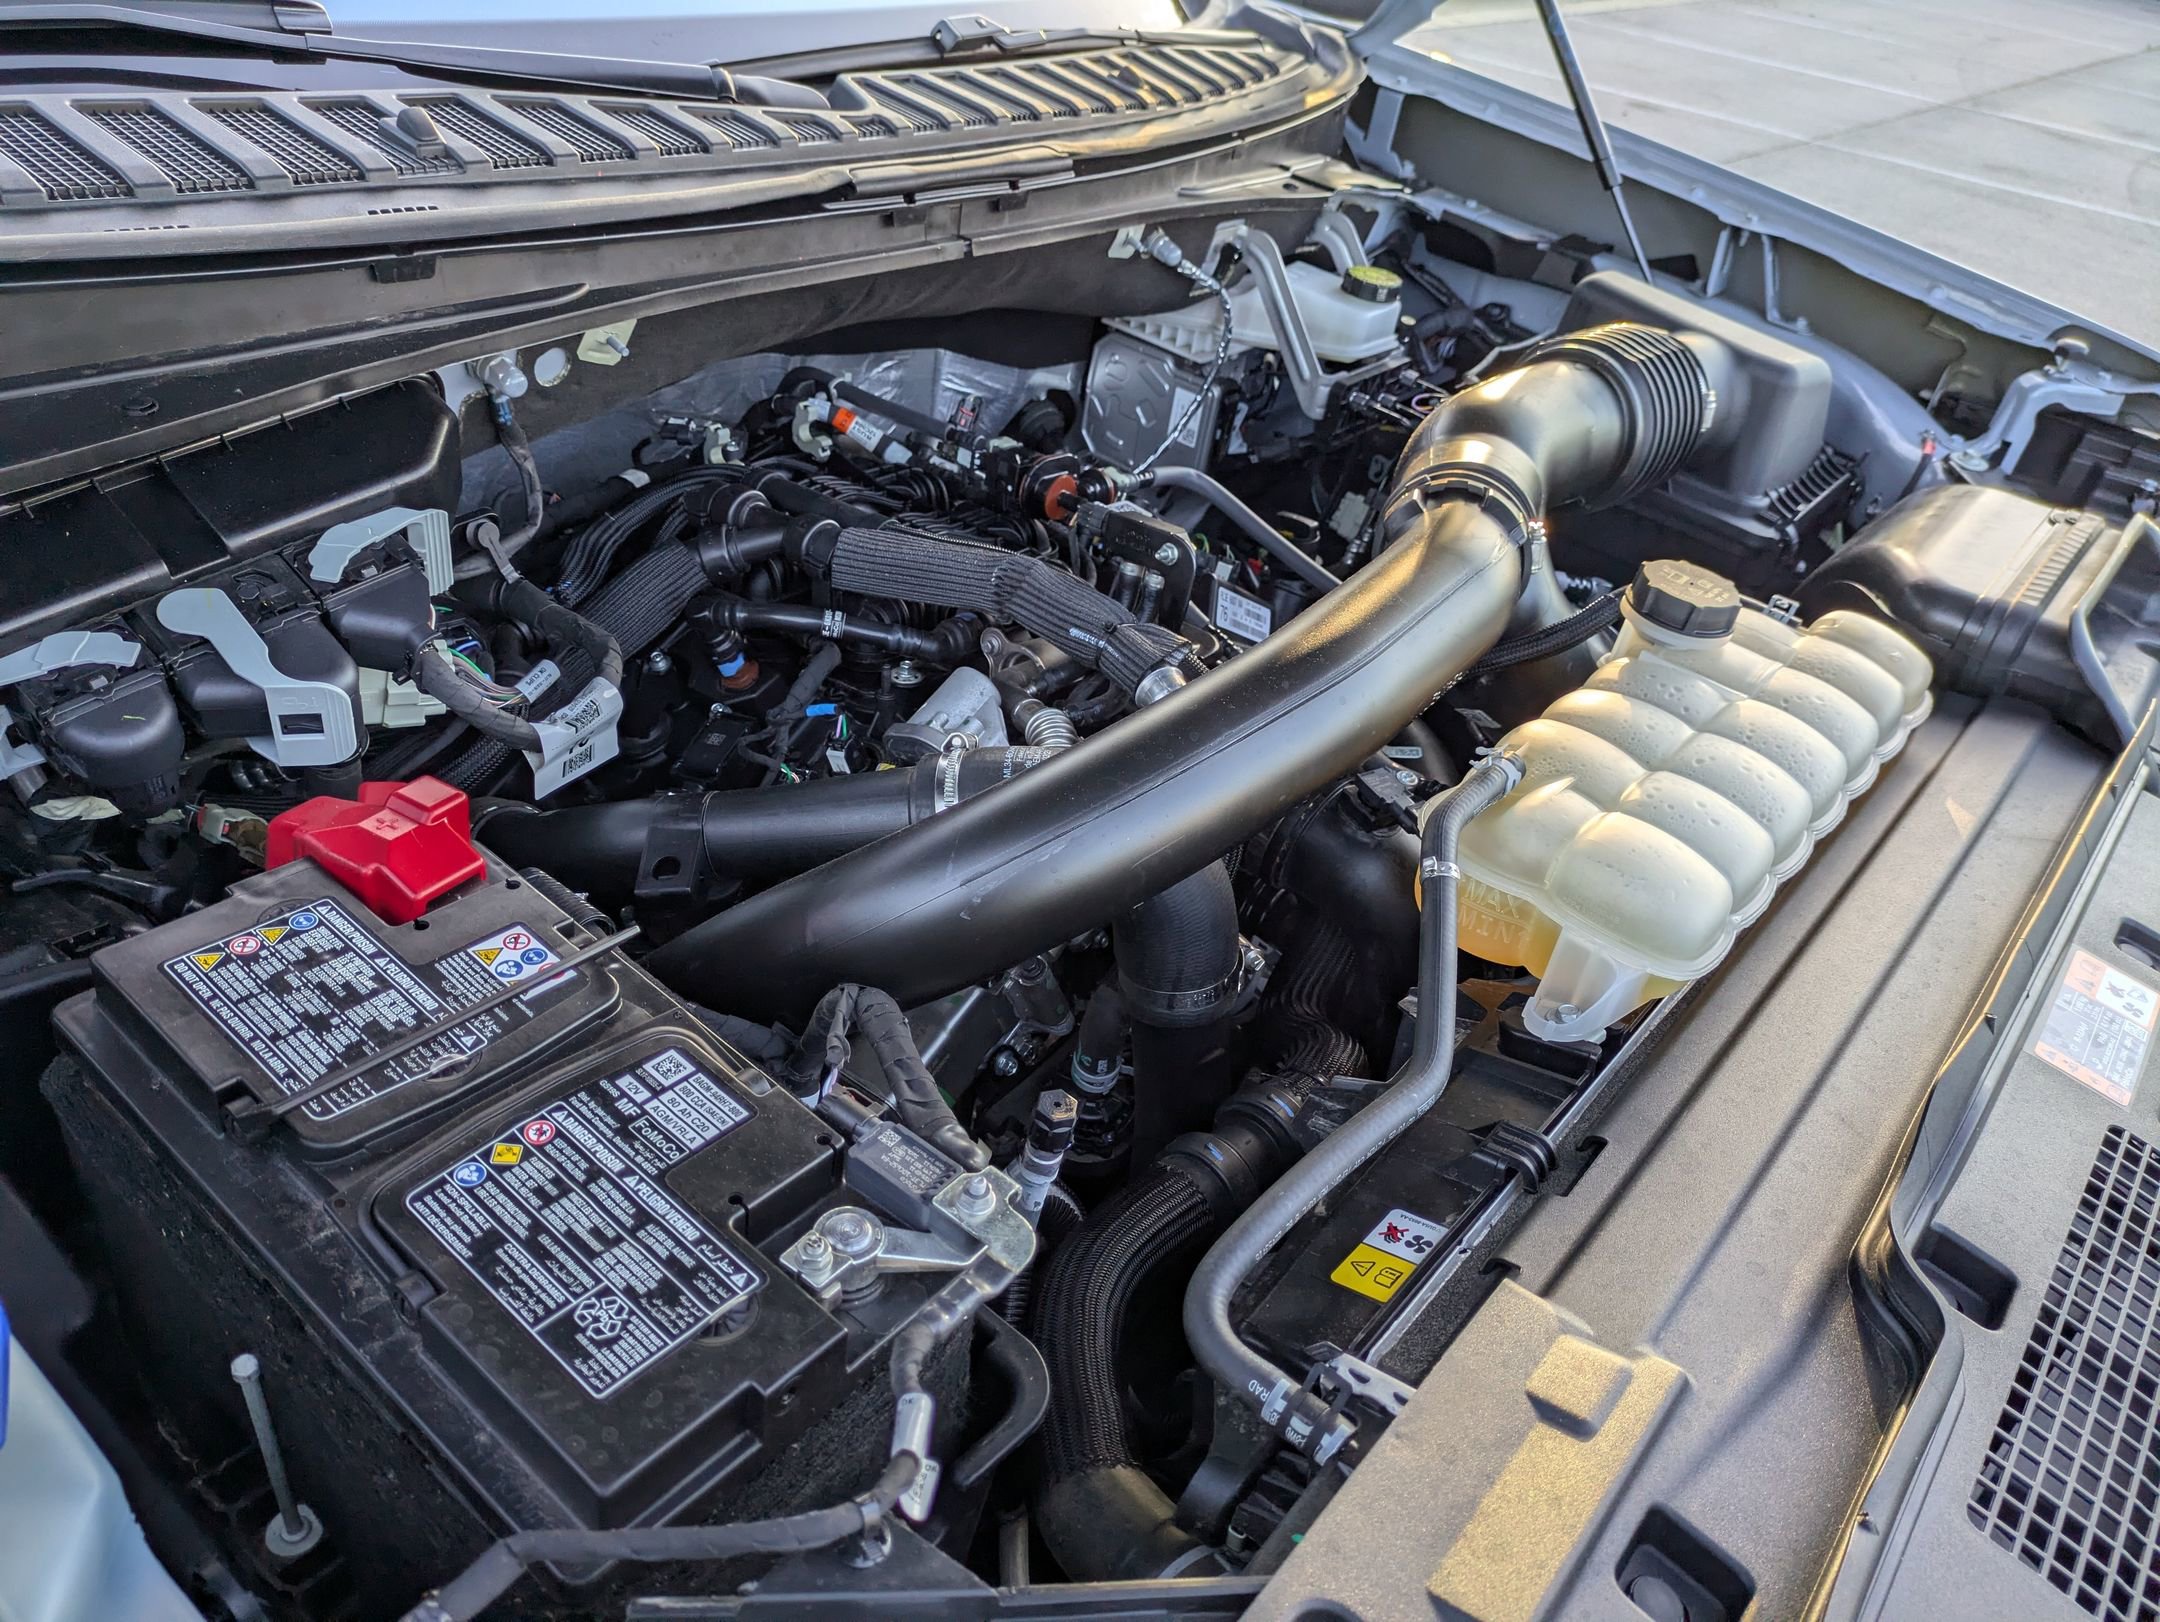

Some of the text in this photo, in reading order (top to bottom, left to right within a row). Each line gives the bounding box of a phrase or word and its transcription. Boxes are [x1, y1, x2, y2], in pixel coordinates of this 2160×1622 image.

[1464, 878, 1519, 919] MAX
[172, 962, 189, 973] DO
[323, 910, 378, 955] DANGER/POISON
[381, 962, 439, 1011] PELIGRO/VENENO
[179, 970, 200, 984] NOT
[190, 981, 215, 1000] OPEN.
[208, 998, 224, 1009] NE
[215, 1005, 234, 1019] PAS
[249, 1039, 267, 1051] NO
[257, 1047, 274, 1059] LA
[623, 1080, 643, 1096] 12V
[676, 1085, 695, 1098] 800
[689, 1094, 708, 1109] CCA
[689, 1076, 745, 1118] BAGM-94RH7-800
[613, 1097, 642, 1119] MF
[664, 1096, 711, 1133] 80 Ah C20
[647, 1104, 699, 1144] AGM/VRLA
[633, 1119, 684, 1159] FoMoCo
[559, 1116, 703, 1241] DANGER/POISON PELIGRO/VENENO
[433, 1187, 485, 1238] Lead Acid Battery
[441, 1182, 492, 1230] NON-SPILLABLE
[412, 1200, 474, 1259] ANTI DÉVERSEMENT
[502, 1242, 567, 1304] CONTRA DERRAMES
[593, 1308, 611, 1323] Pb
[1248, 1379, 1270, 1402] RAD
